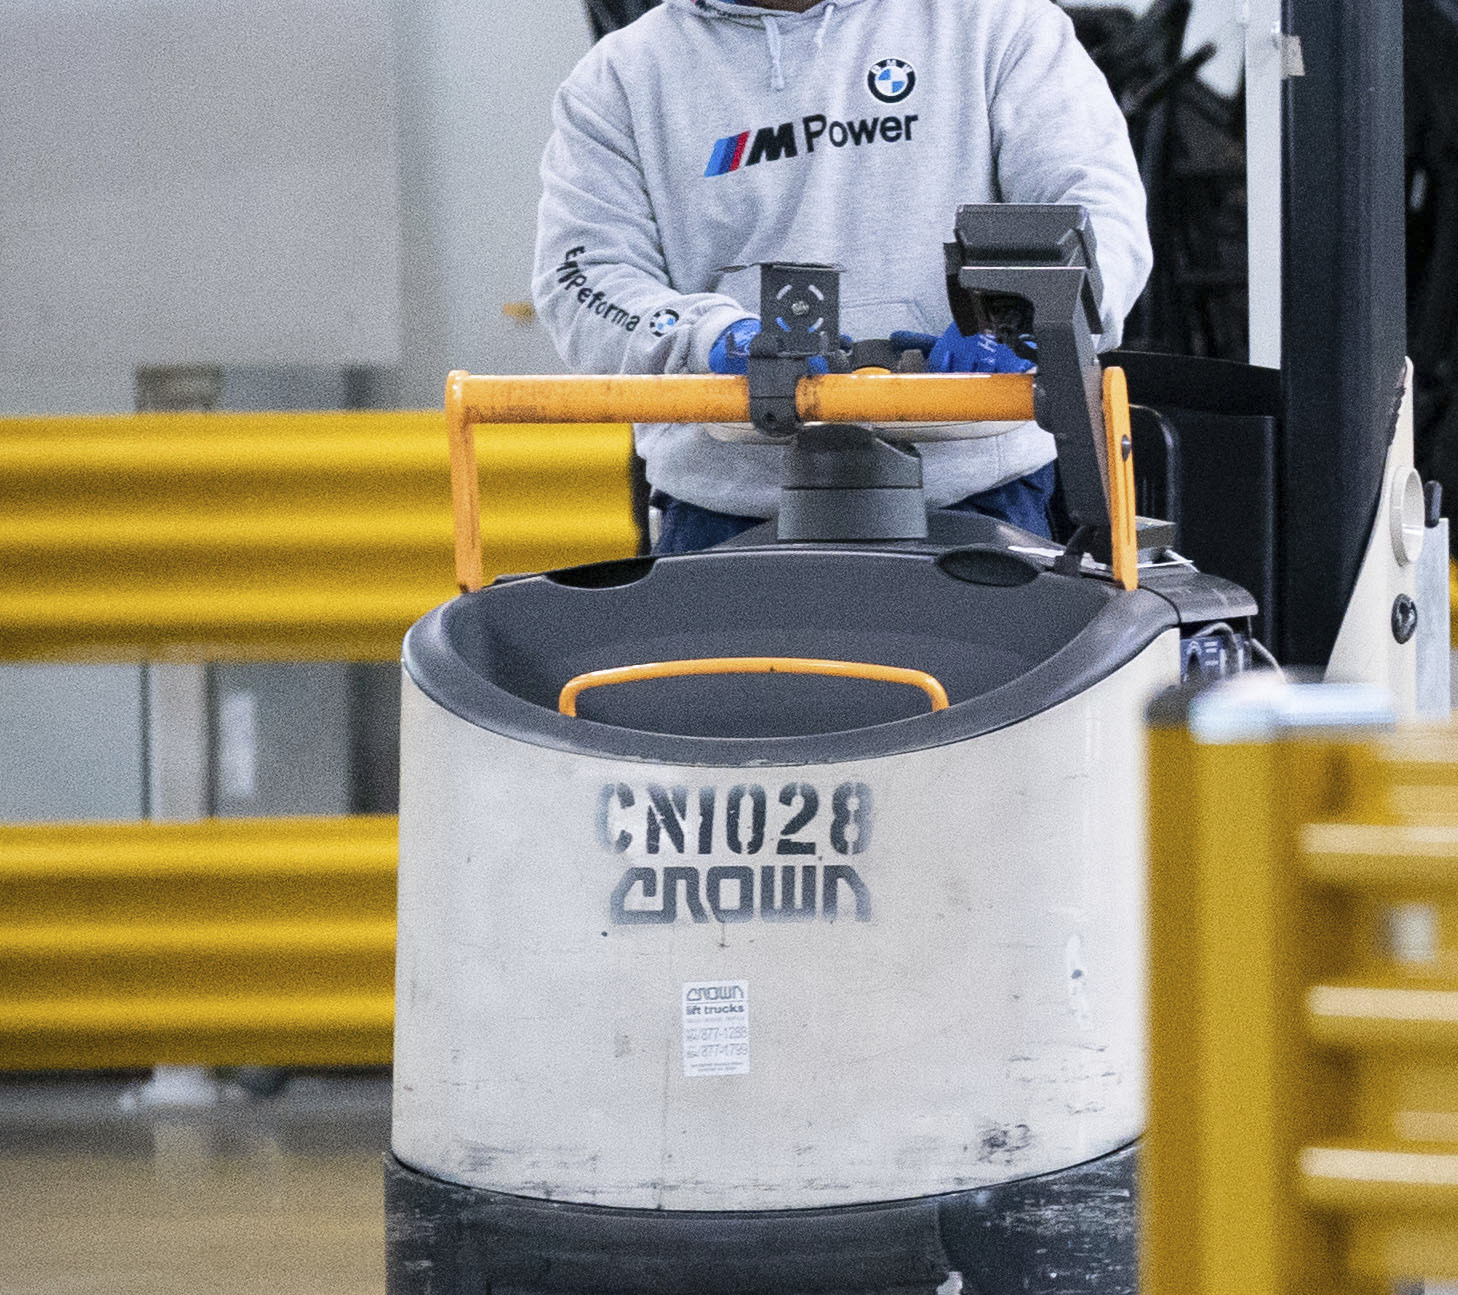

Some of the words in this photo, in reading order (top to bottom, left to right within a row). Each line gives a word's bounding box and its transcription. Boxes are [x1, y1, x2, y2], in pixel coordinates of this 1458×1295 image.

[745, 121, 798, 167] M
[802, 114, 919, 154] Power
[597, 782, 874, 855] CN1028
[704, 1004, 745, 1015] trucks
